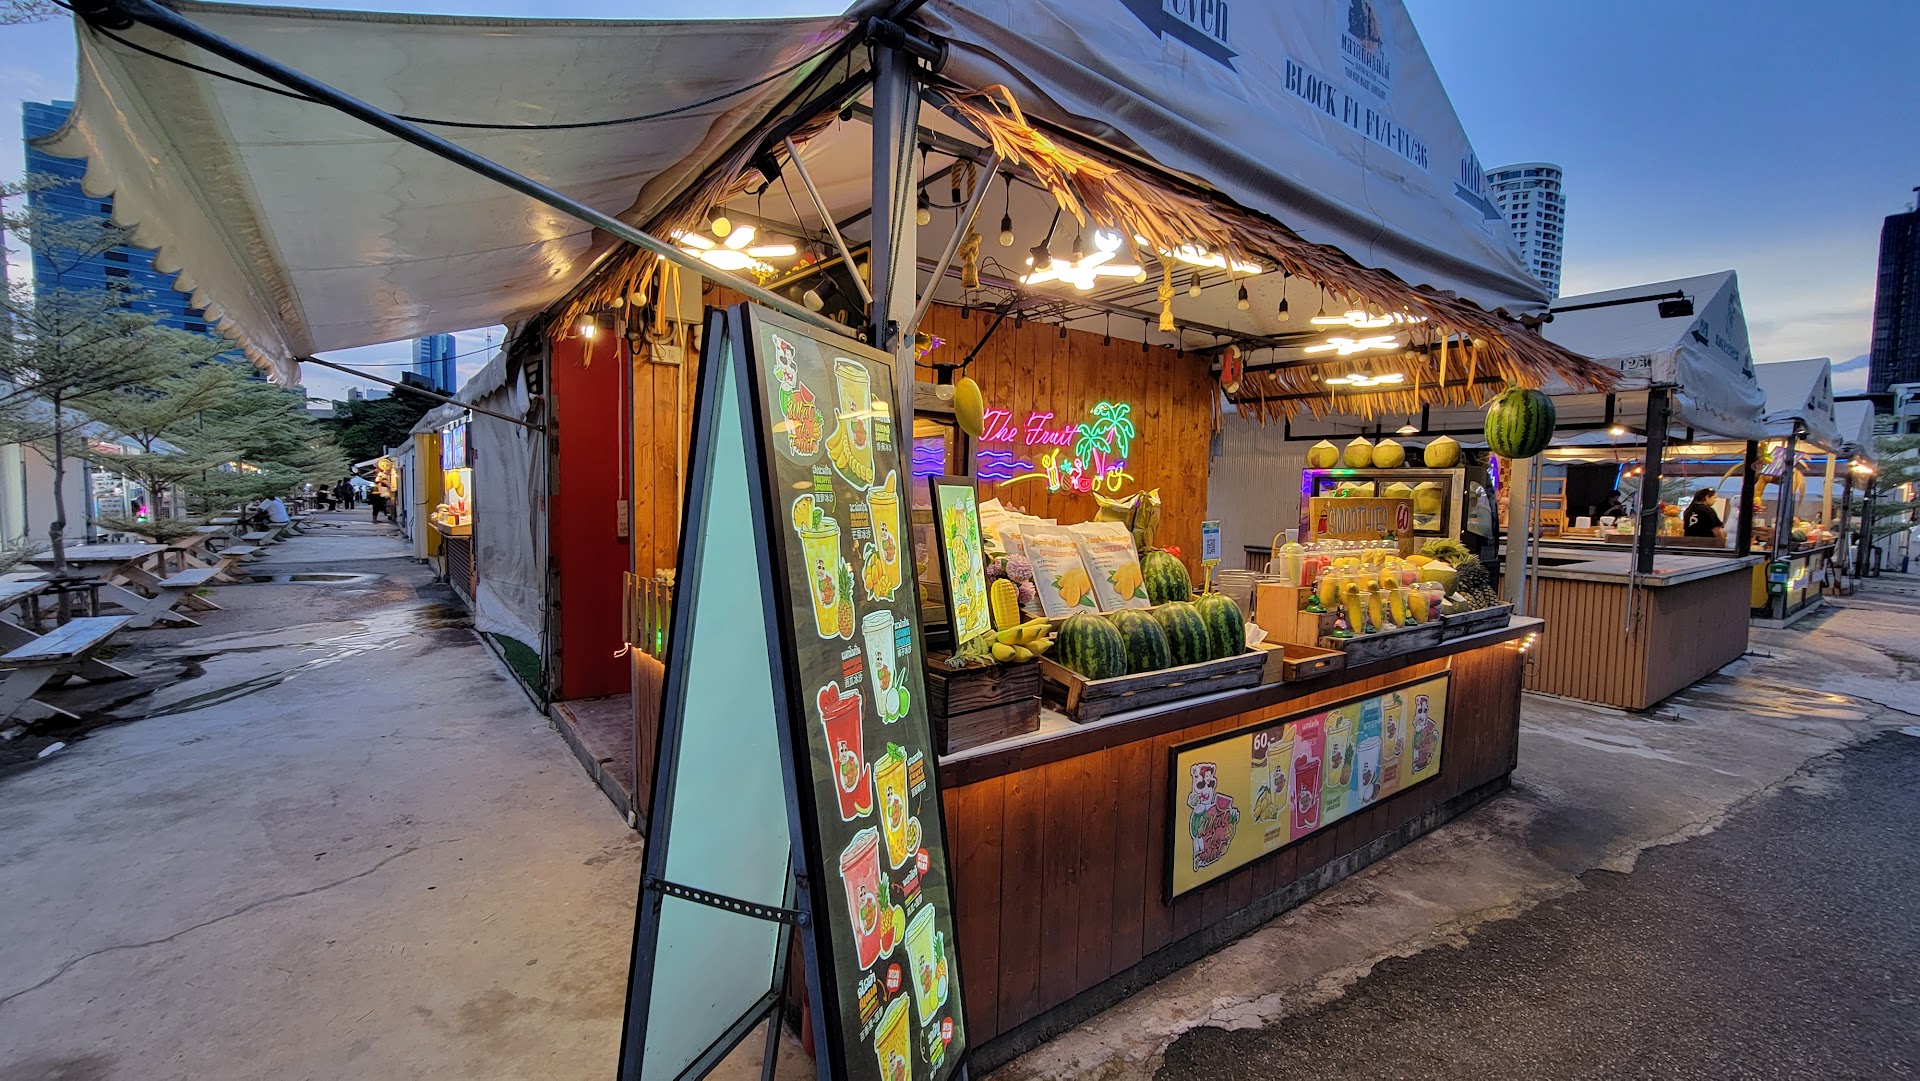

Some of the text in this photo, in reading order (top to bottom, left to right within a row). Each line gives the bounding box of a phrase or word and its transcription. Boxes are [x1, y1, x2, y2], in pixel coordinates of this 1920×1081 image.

[1285, 59, 1336, 117] BLOCK
[1344, 95, 1359, 129] F1
[1366, 108, 1428, 170] F1/1-F1/36
[1461, 153, 1480, 194] odd
[979, 408, 1080, 446] The Fruit
[1327, 506, 1389, 535] SMOOTHIES
[1396, 504, 1409, 531] 60
